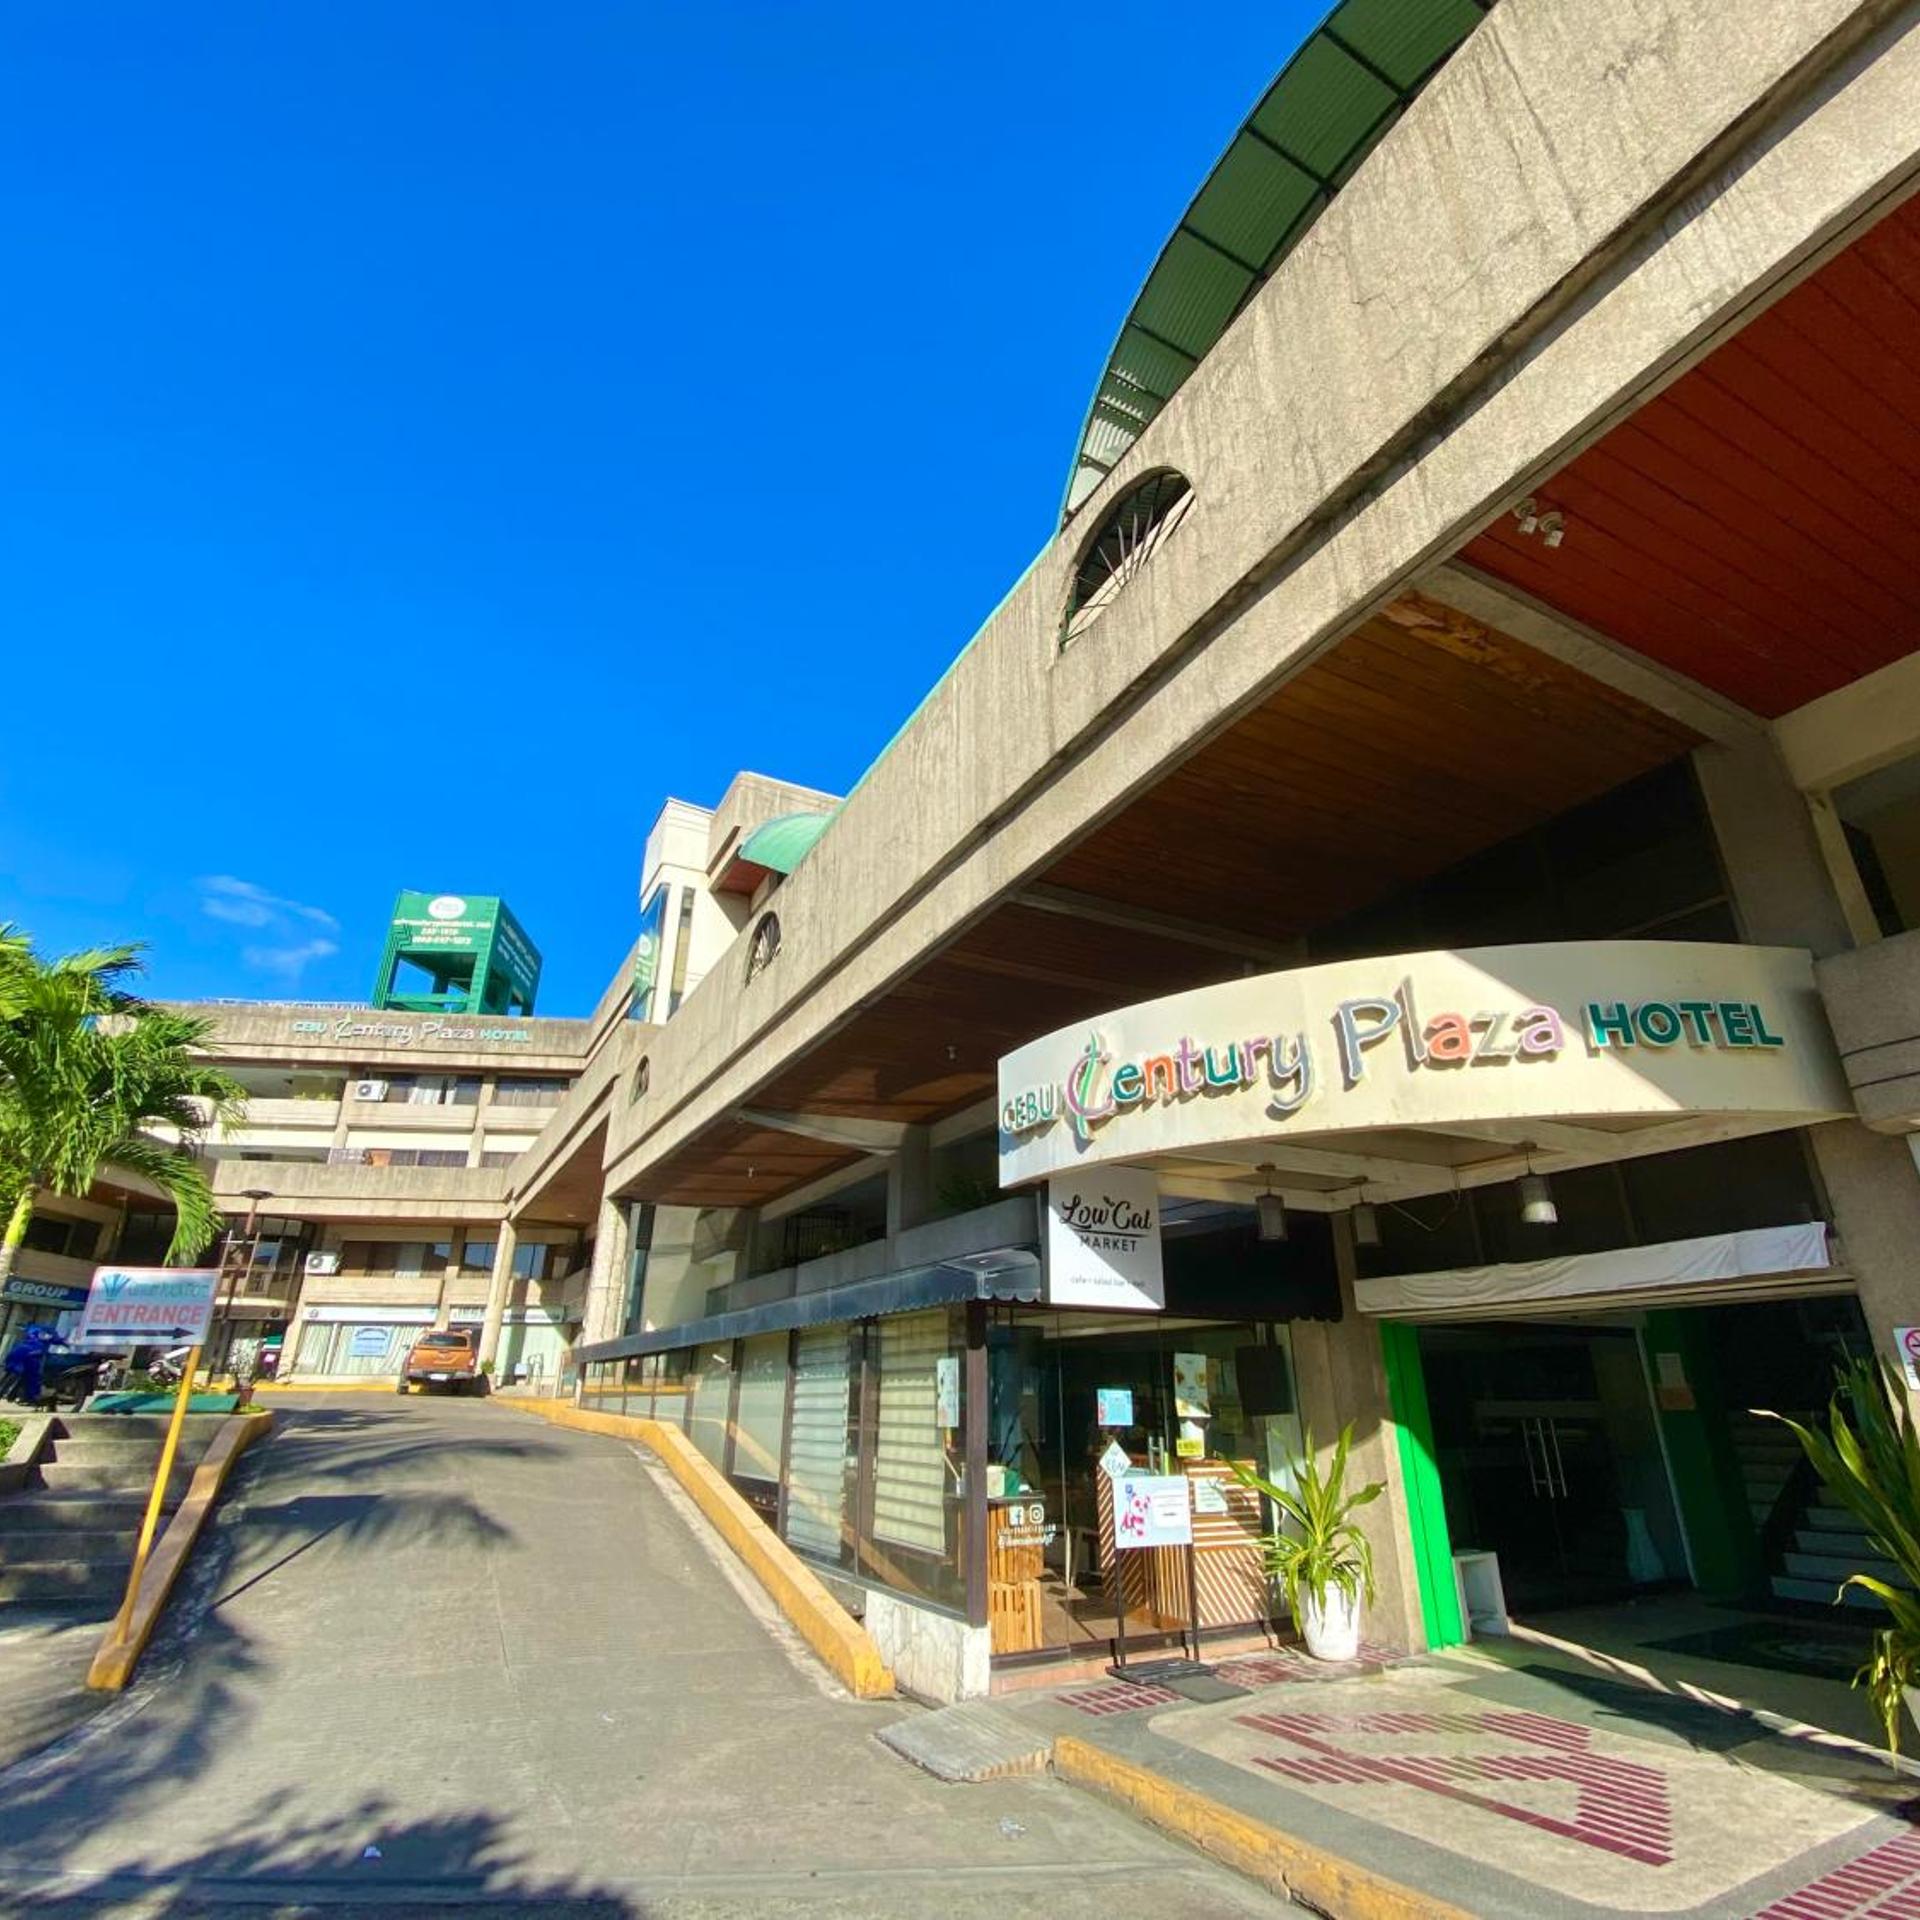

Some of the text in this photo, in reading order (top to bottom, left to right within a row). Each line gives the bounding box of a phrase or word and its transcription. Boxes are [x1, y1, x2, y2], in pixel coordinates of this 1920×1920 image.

[292, 1013, 531, 1044] CEBU Century Plaza HOTEL
[1001, 974, 1785, 1139] CEBU Century Plaza HOTEL
[1079, 1236, 1138, 1253] MARKET
[8, 1280, 70, 1299] GROUP
[90, 1303, 205, 1325] ENTRANCE
